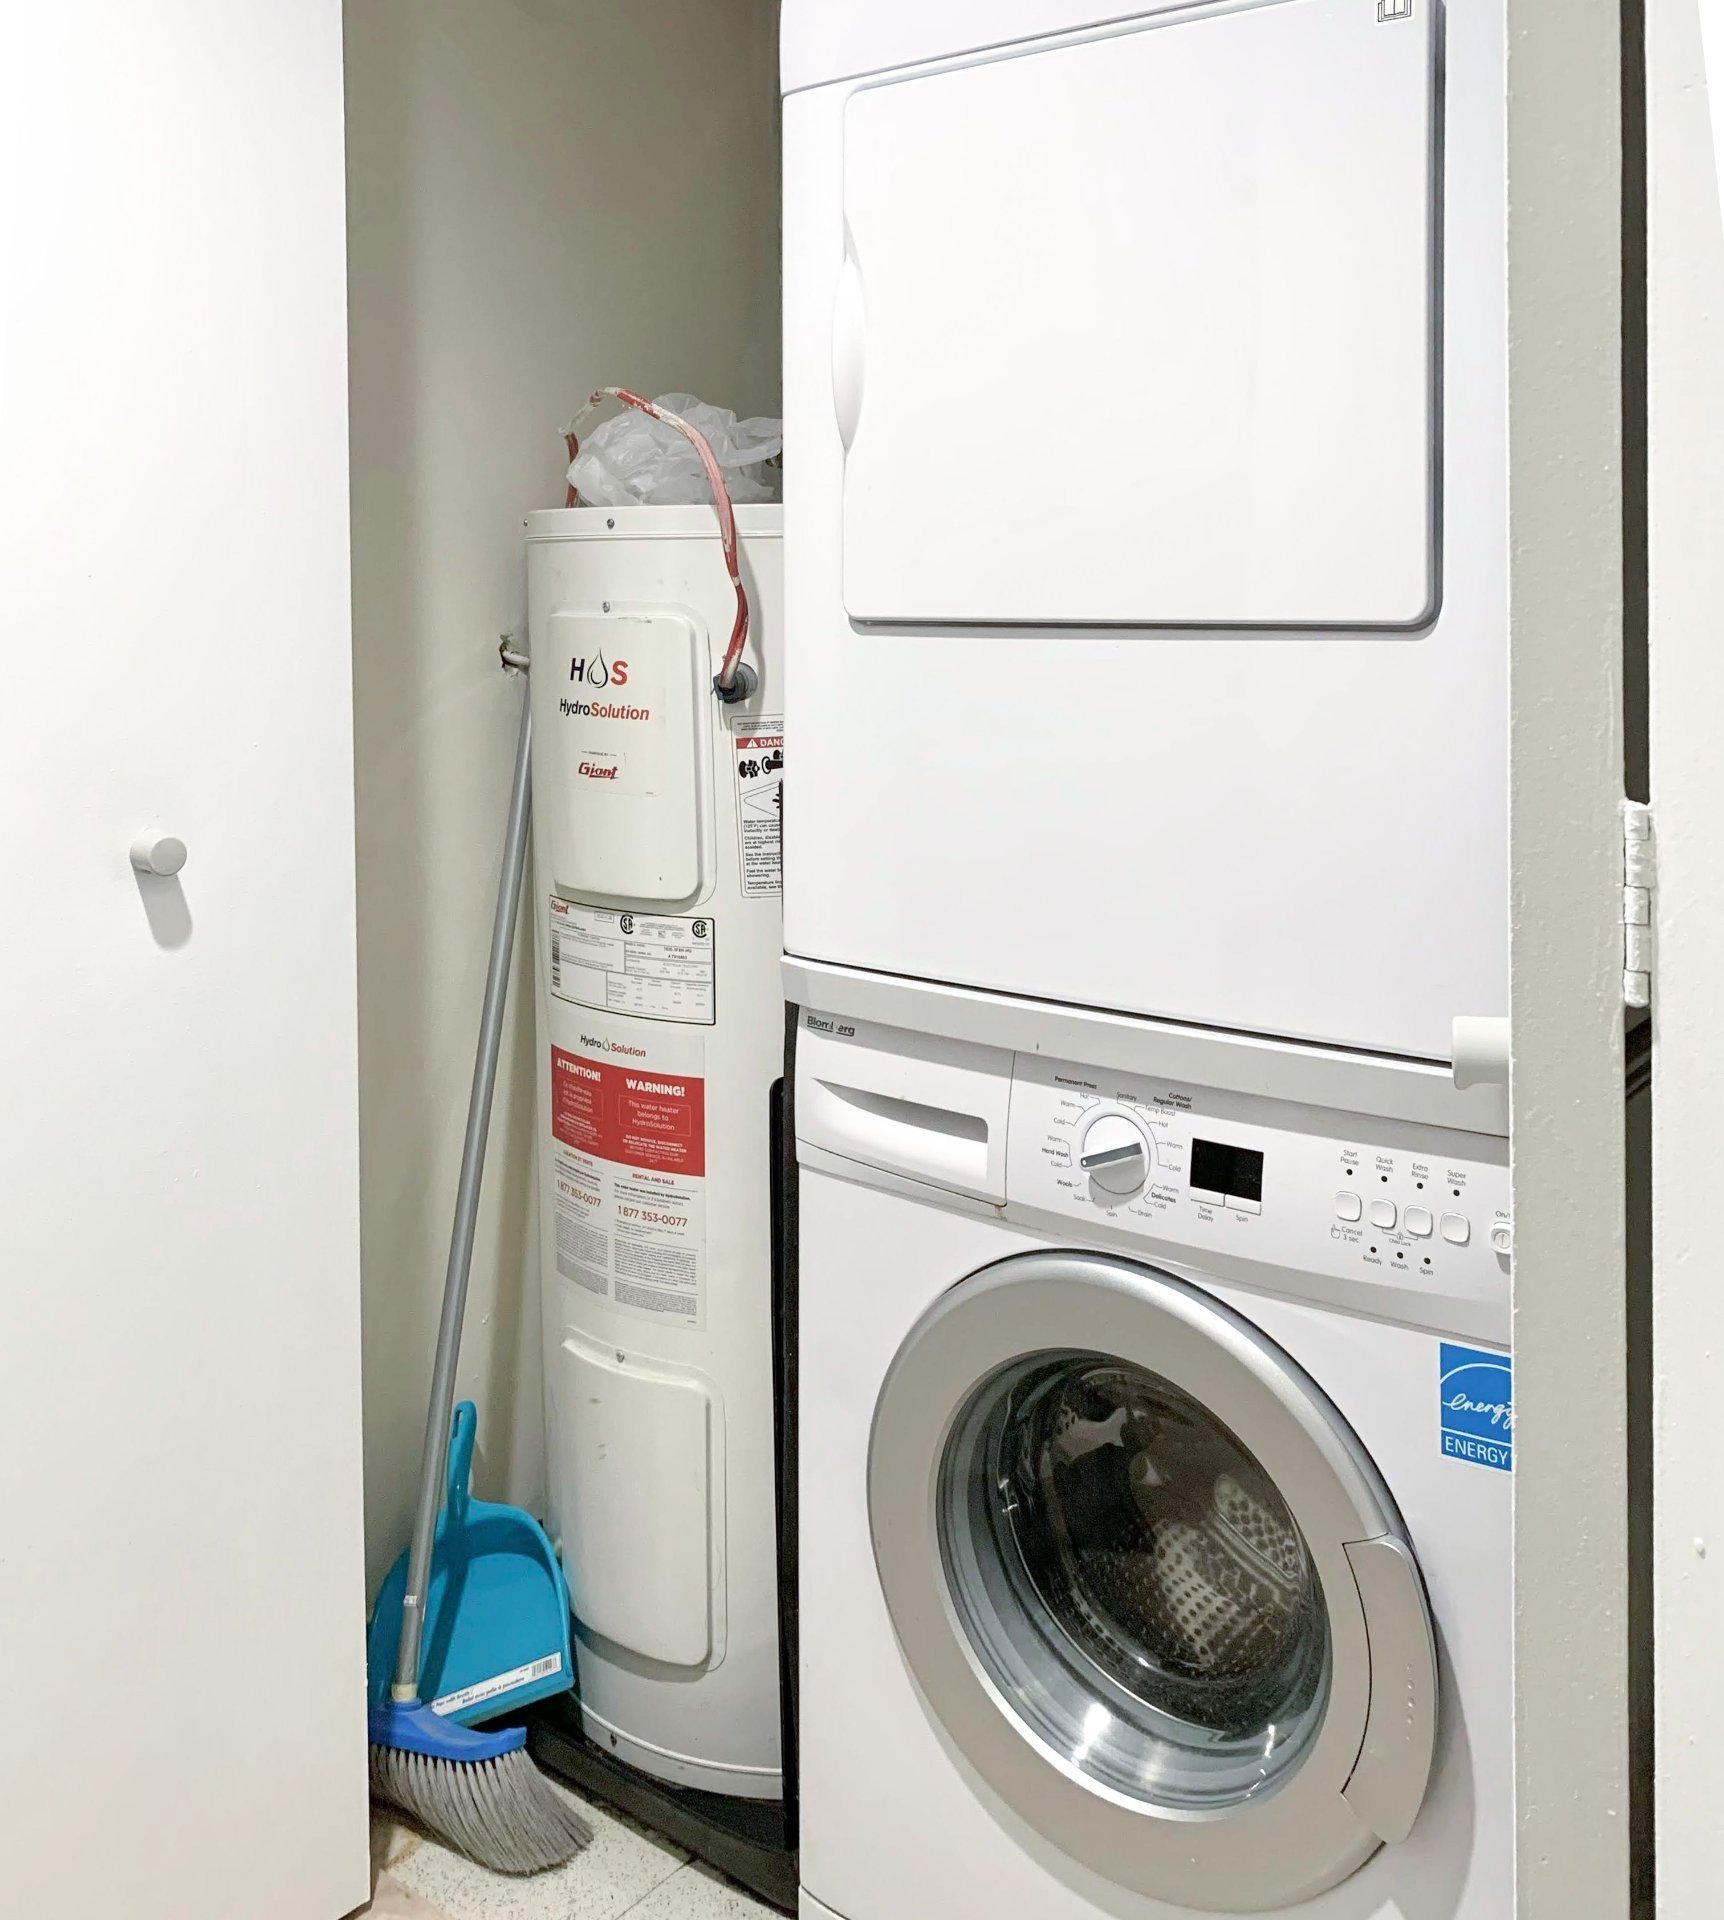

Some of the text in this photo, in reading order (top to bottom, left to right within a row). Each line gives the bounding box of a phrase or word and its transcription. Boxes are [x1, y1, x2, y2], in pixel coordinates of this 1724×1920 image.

[559, 698, 650, 721] HydroSolution
[578, 761, 619, 780] Giant
[551, 900, 570, 915] Giant
[580, 1034, 646, 1058] Hydro Solution
[557, 1057, 601, 1083] ATTENTION!
[626, 1078, 686, 1098] WARNING!
[1054, 1075, 1097, 1090] Permanent Press
[1116, 1091, 1138, 1102] Sanitary
[629, 1100, 679, 1114] This water heater
[1153, 1096, 1192, 1110] Regular Wash
[1145, 1104, 1161, 1114] Temp
[637, 1110, 661, 1121] belongs
[1343, 1149, 1358, 1158] Start
[1340, 1156, 1360, 1166] Pause
[1375, 1155, 1394, 1166] Quick
[1168, 1163, 1182, 1173] Cold
[1375, 1163, 1394, 1173] Wash
[1412, 1162, 1429, 1173] Extra
[632, 1173, 650, 1182] RENTAL
[662, 1178, 675, 1186] SALE
[1411, 1170, 1429, 1180] Rinse
[1447, 1169, 1466, 1180] Super
[1447, 1177, 1466, 1187] Wash
[561, 1181, 570, 1194] 877
[571, 1187, 602, 1208] 353-0077
[1151, 1191, 1177, 1204] Delicates
[1154, 1201, 1167, 1210] Cold
[618, 1205, 622, 1215] 1
[623, 1206, 639, 1219] 877
[641, 1210, 688, 1228] 353-0077
[1137, 1209, 1153, 1218] Drain
[1495, 1210, 1510, 1219] On/
[1341, 1226, 1363, 1237] Cancel
[1362, 1254, 1382, 1266] Ready
[1390, 1260, 1409, 1270] Wash
[1419, 1266, 1434, 1276] Spin
[1444, 1436, 1509, 1465] ENERGY
